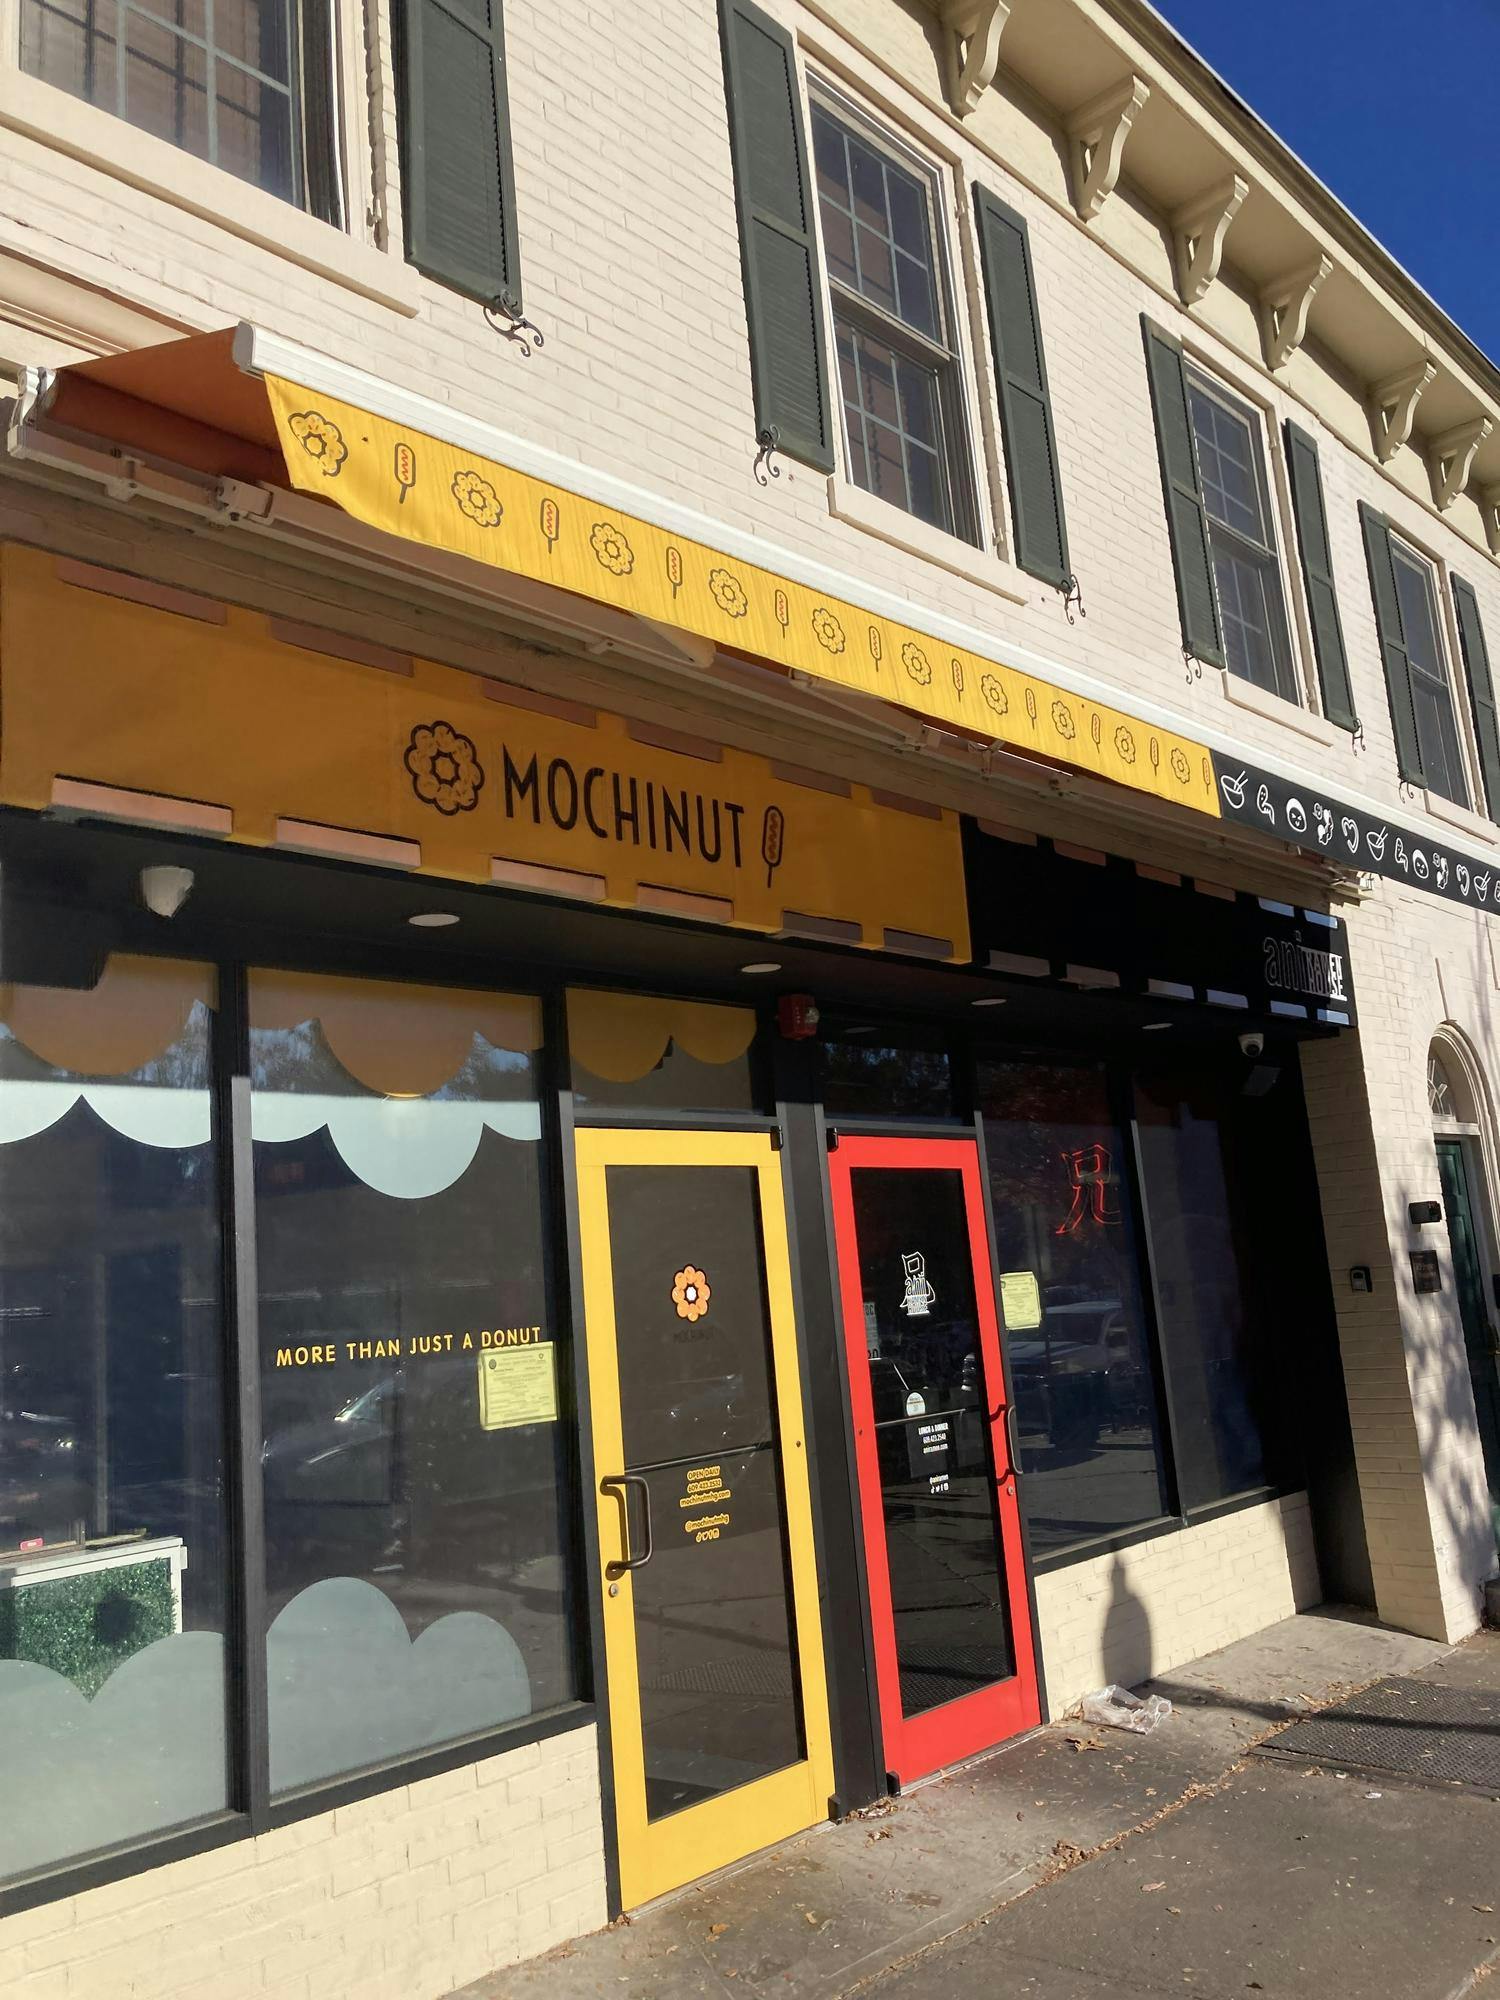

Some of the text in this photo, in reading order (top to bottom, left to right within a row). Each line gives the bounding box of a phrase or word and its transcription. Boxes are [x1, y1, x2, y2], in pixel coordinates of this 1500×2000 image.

[502, 743, 745, 868] MOCHINUT
[276, 1326, 541, 1367] MORE THAN JUST A DONUT
[687, 1466, 720, 1480] OPEN DAILY
